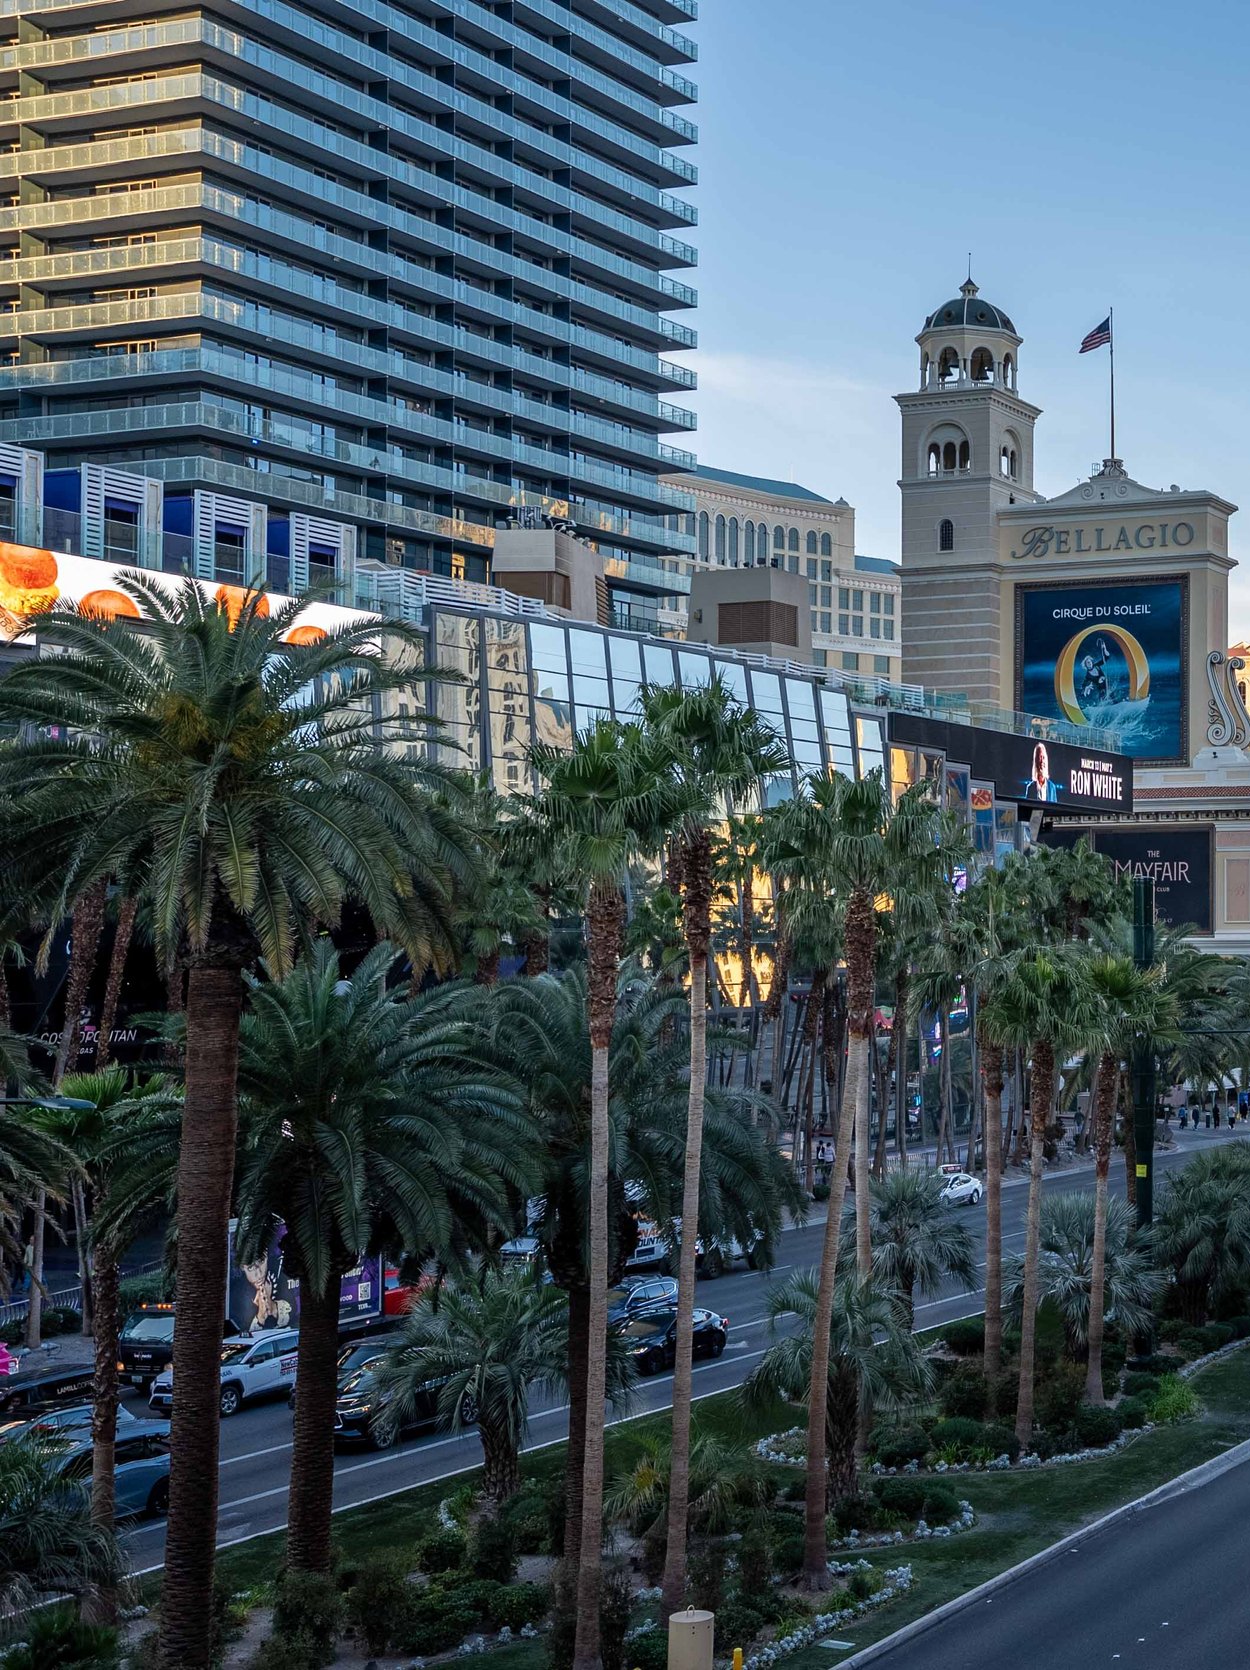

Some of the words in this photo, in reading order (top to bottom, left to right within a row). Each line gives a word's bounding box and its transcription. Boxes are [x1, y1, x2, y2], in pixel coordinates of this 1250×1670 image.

[1011, 522, 1194, 559] BELLAGIO
[1052, 608, 1093, 620] CIRQUE
[1095, 606, 1111, 616] DU
[1113, 604, 1151, 616] SOLEIL
[1070, 769, 1091, 796] RON
[1092, 773, 1123, 801] WHITE
[1115, 859, 1191, 884] MAYFAIR
